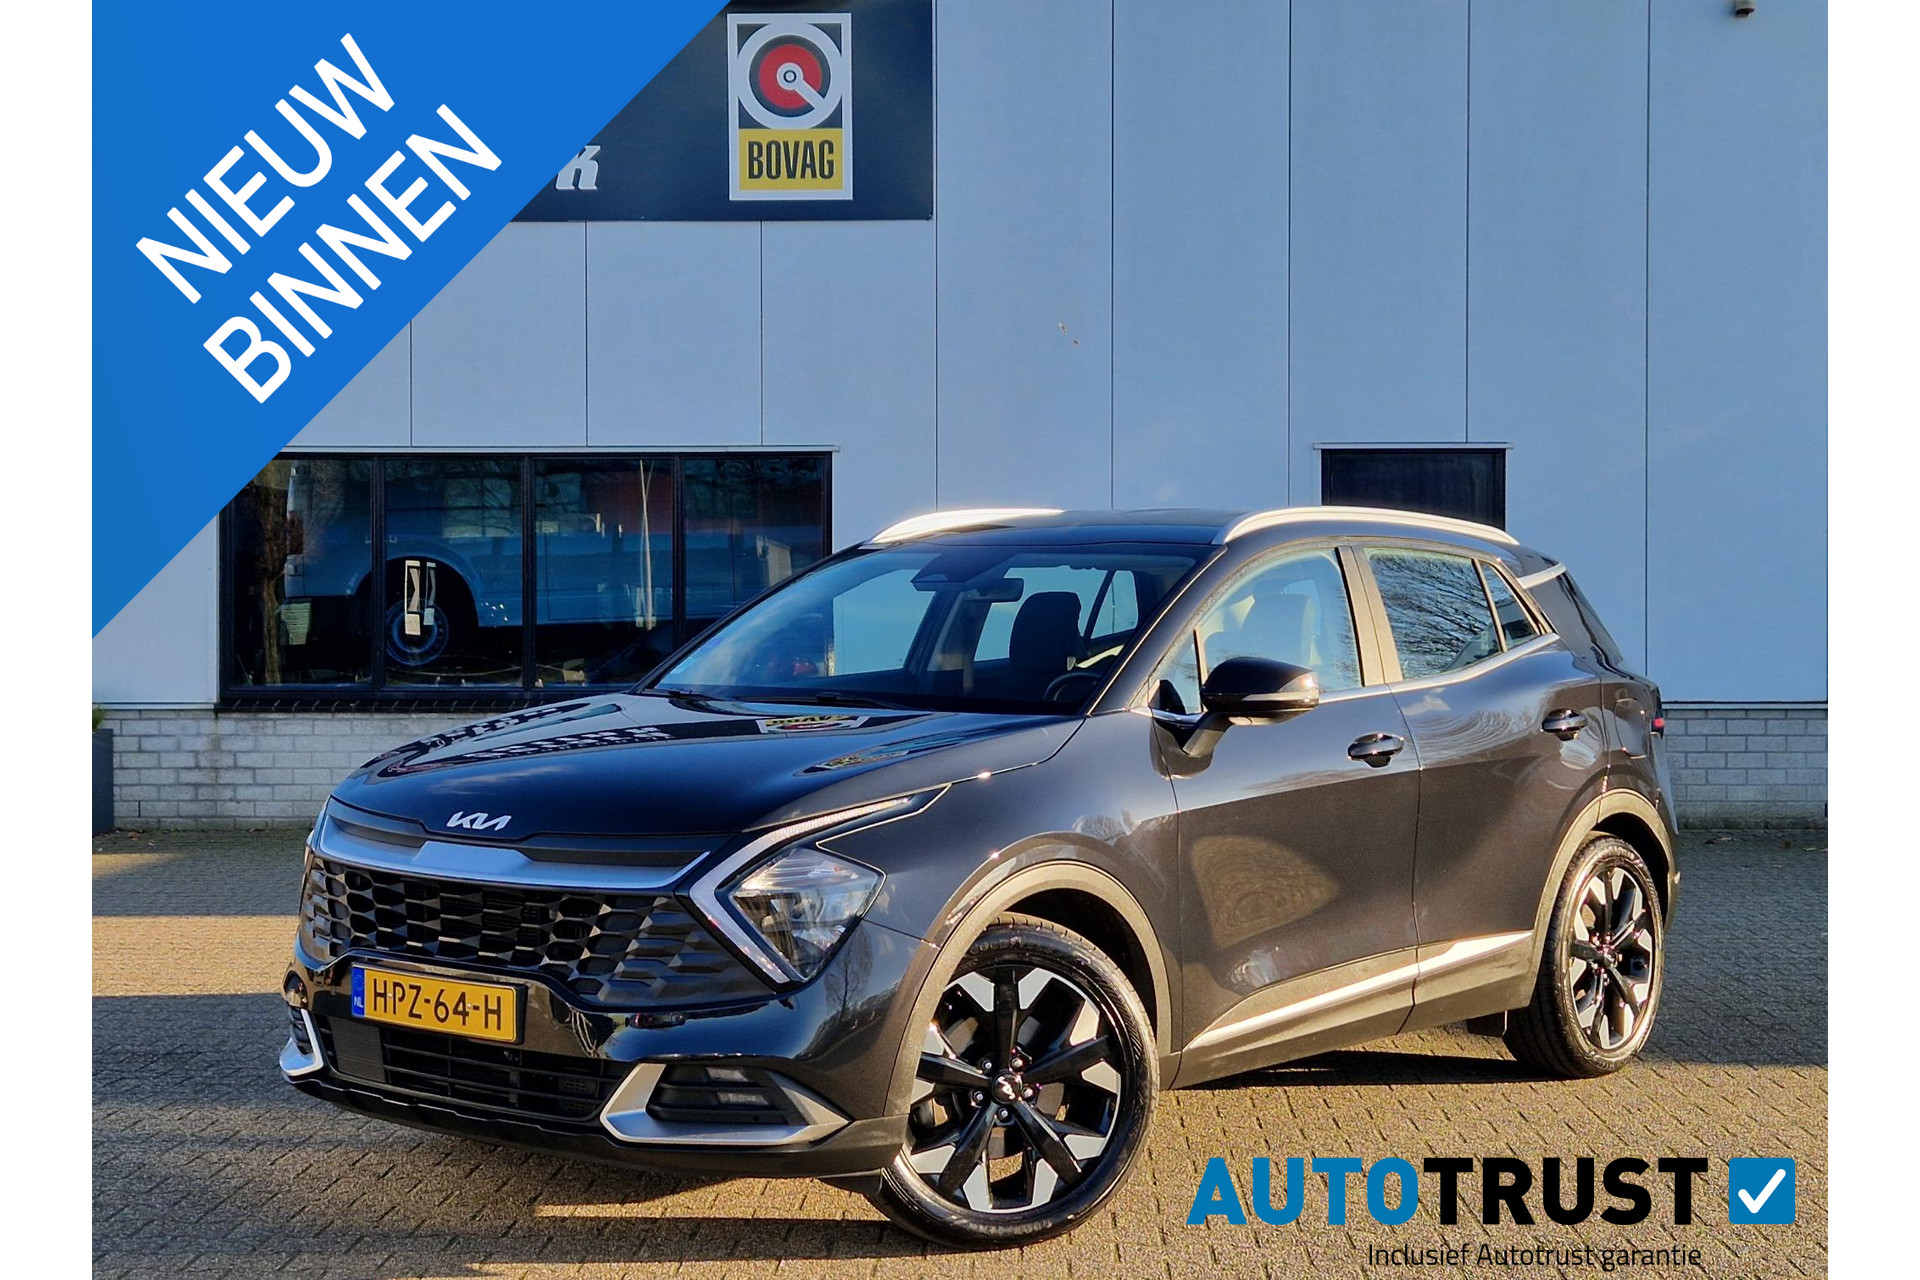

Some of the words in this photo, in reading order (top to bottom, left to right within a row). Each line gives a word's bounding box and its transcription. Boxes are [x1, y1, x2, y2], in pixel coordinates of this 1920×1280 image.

[747, 139, 834, 180] BOVAG
[353, 996, 364, 1008] NL
[373, 978, 501, 1031] HPZ-64-H
